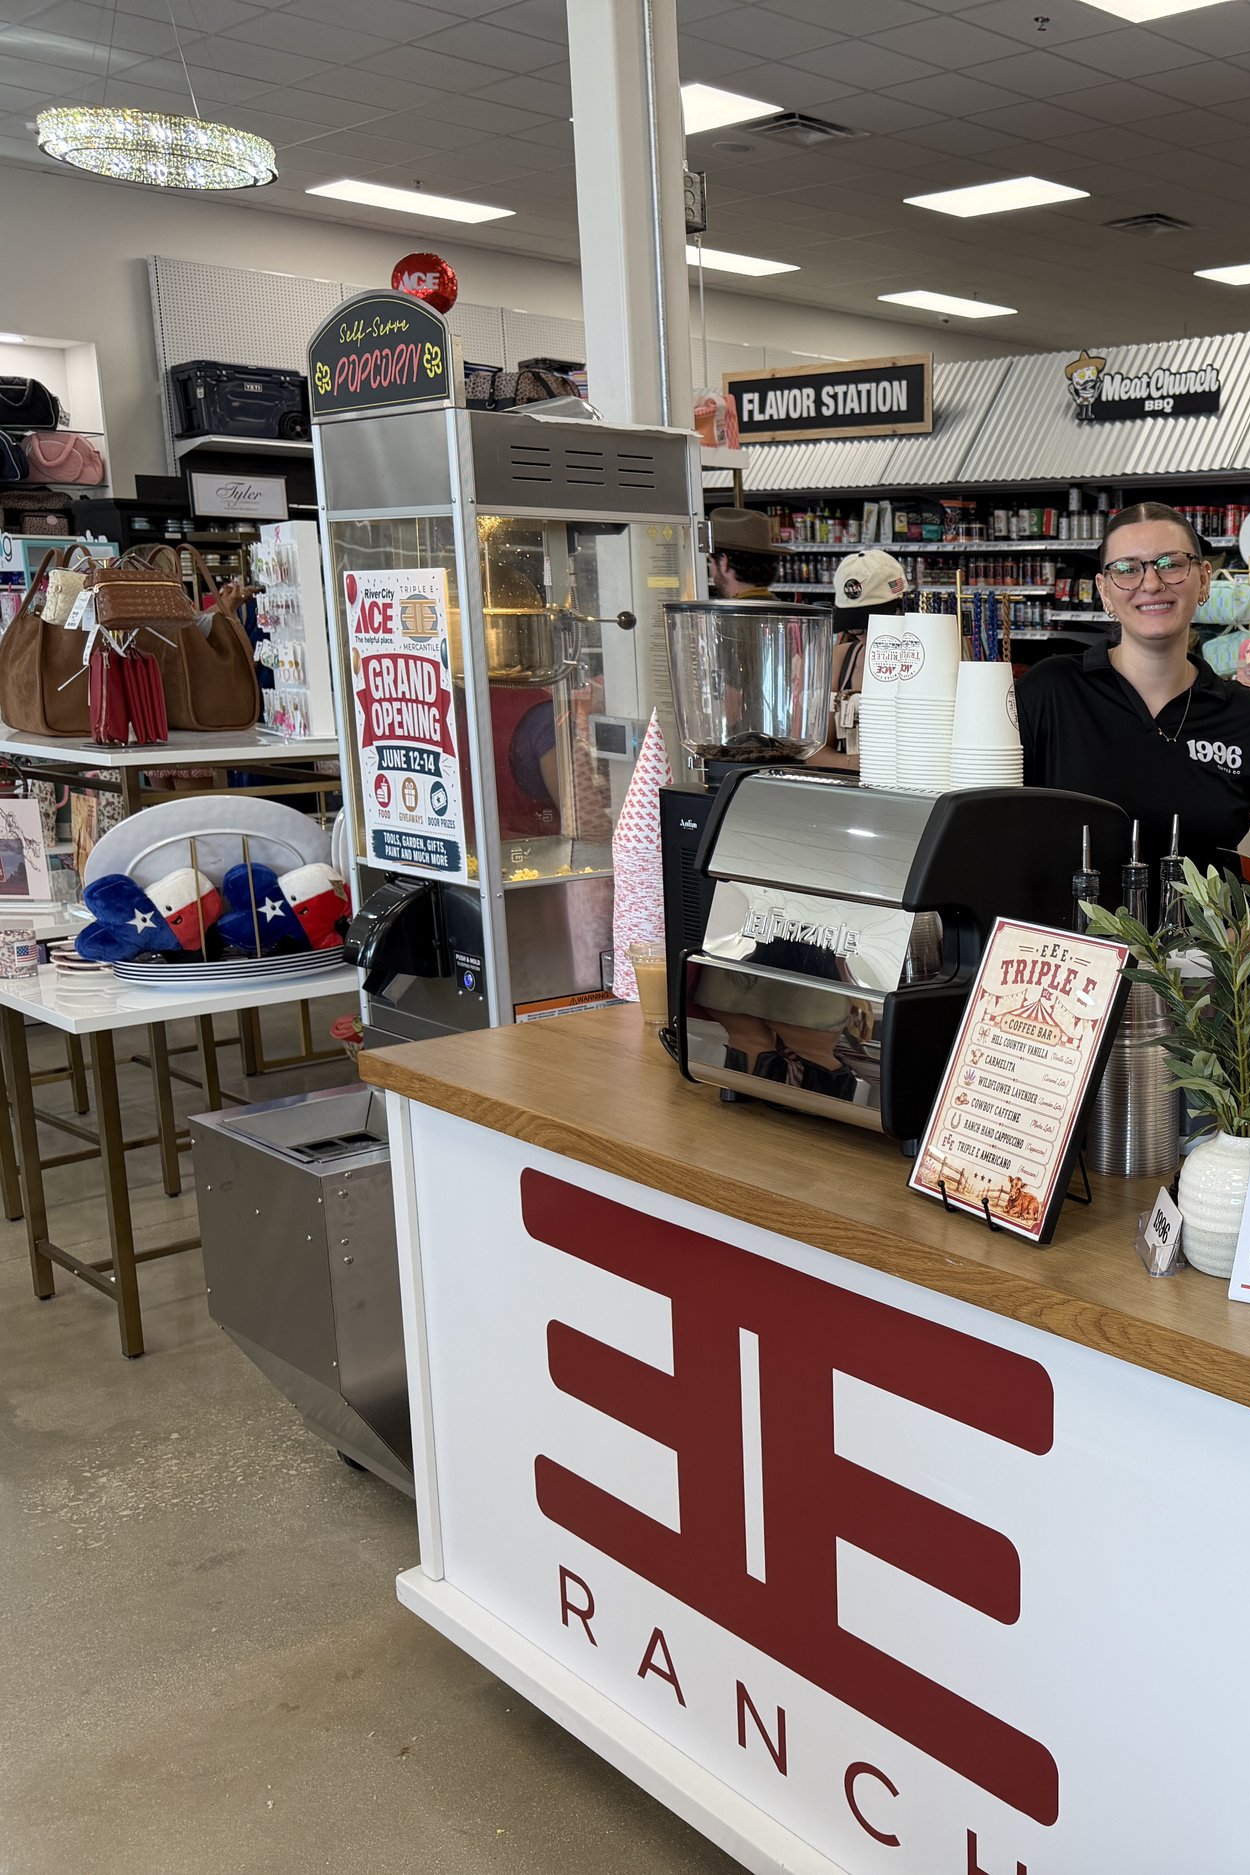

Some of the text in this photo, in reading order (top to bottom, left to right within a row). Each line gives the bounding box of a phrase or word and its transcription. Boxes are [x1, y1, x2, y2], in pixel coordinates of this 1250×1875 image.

[339, 316, 409, 347] Self-Serve
[334, 342, 421, 396] POPCORN
[1101, 365, 1220, 401] Meat Church
[742, 380, 908, 422] FLAVOR STATION
[1144, 398, 1174, 413] BBQ
[216, 482, 262, 507] Tyler
[400, 585, 434, 593] TRIPLE E
[354, 597, 394, 635] ACE
[364, 636, 380, 645] helpful
[380, 637, 395, 645] place.
[403, 643, 440, 652] MERCANTILE
[368, 658, 437, 704] GRAND
[371, 701, 441, 742] OPENING
[381, 749, 435, 773] JUNE 12-14
[1186, 739, 1243, 769] 1996
[378, 809, 391, 819] FOOD
[399, 812, 424, 825] GIVEAWAYS
[427, 816, 456, 830] DOOR PRIZES
[383, 832, 447, 855] TOOLS, GARDEN, GIFTS,
[385, 845, 449, 867] PAINT AND MUCH MORE
[1000, 959, 1079, 997] TRIPLE
[1008, 1019, 1053, 1041] COFFEE BAR
[990, 1034, 1049, 1060] HILL COUNTRY VANILLA
[984, 1054, 1016, 1073] CARMELITA
[977, 1075, 1012, 1097] WILDFLOWER
[1011, 1086, 1039, 1105] LAVENDER
[970, 1097, 994, 1114] COWBOY
[994, 1105, 1022, 1123] CAFFEINE
[963, 1119, 1024, 1149] RANCH HAND CAPPUCCINO
[956, 1141, 975, 1157] TRIPLE
[975, 1147, 980, 1158] E
[980, 1149, 1012, 1169] AMERICANO
[1153, 1208, 1171, 1244] 1996
